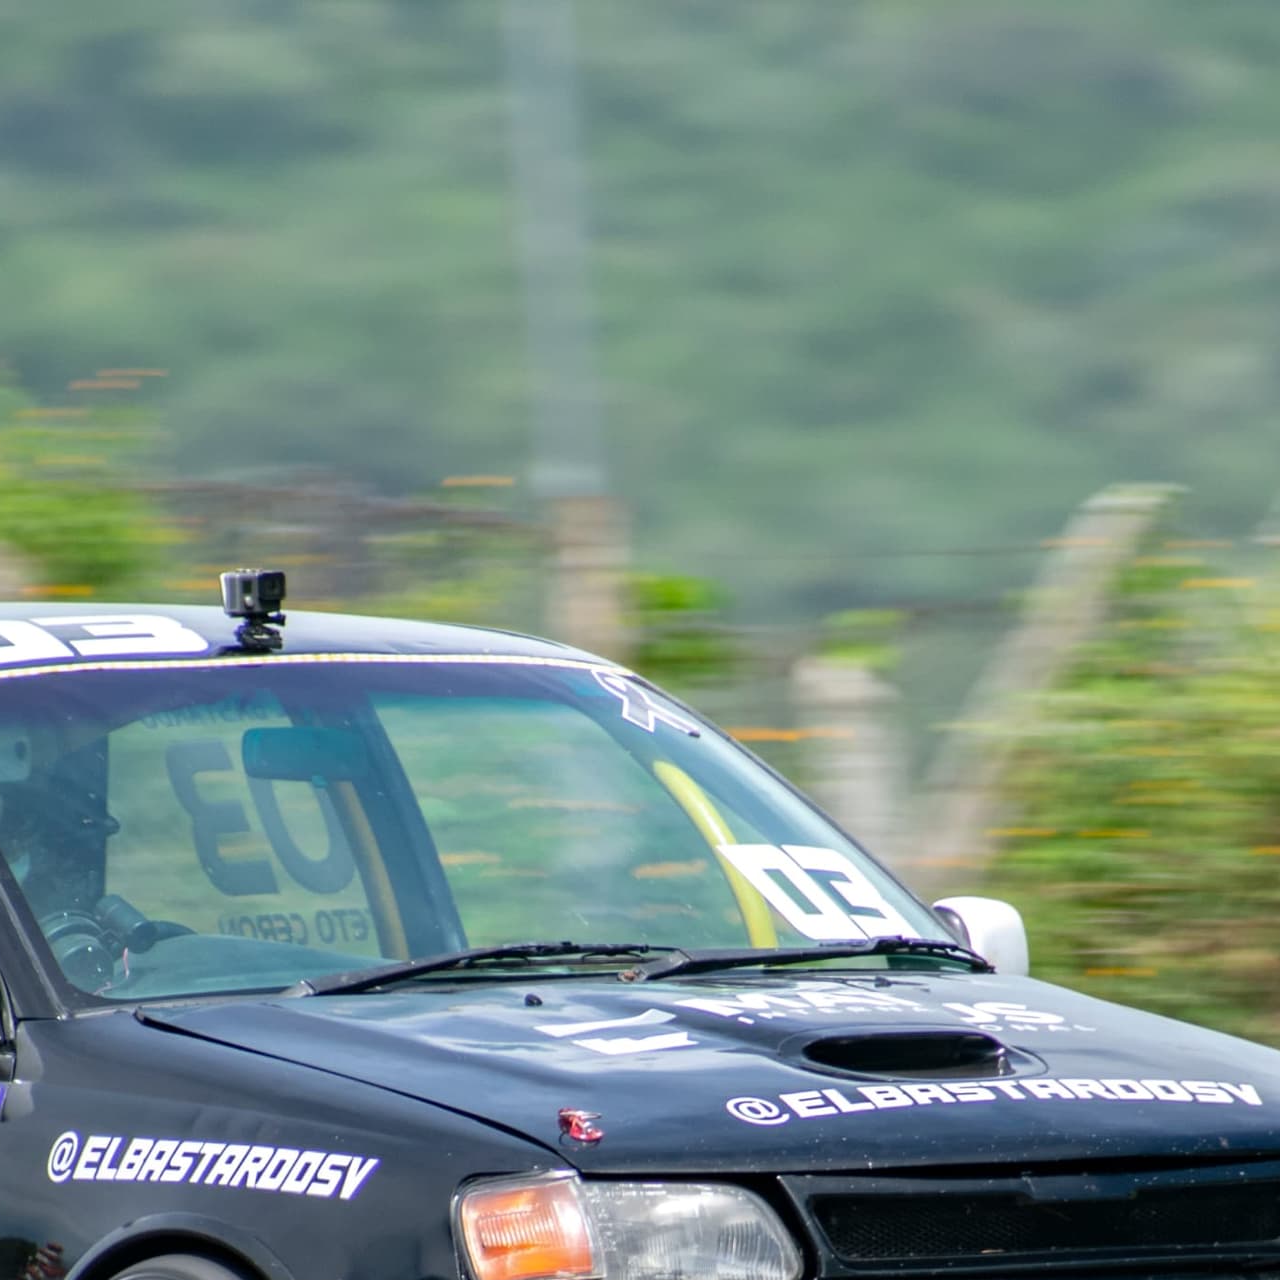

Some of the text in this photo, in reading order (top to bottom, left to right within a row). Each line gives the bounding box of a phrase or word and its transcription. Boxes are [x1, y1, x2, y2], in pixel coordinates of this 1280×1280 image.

[717, 844, 921, 940] 03
[726, 1079, 1263, 1126] @ELBASTARDOSV
[47, 1131, 381, 1200] @ELBASTARDOSV
